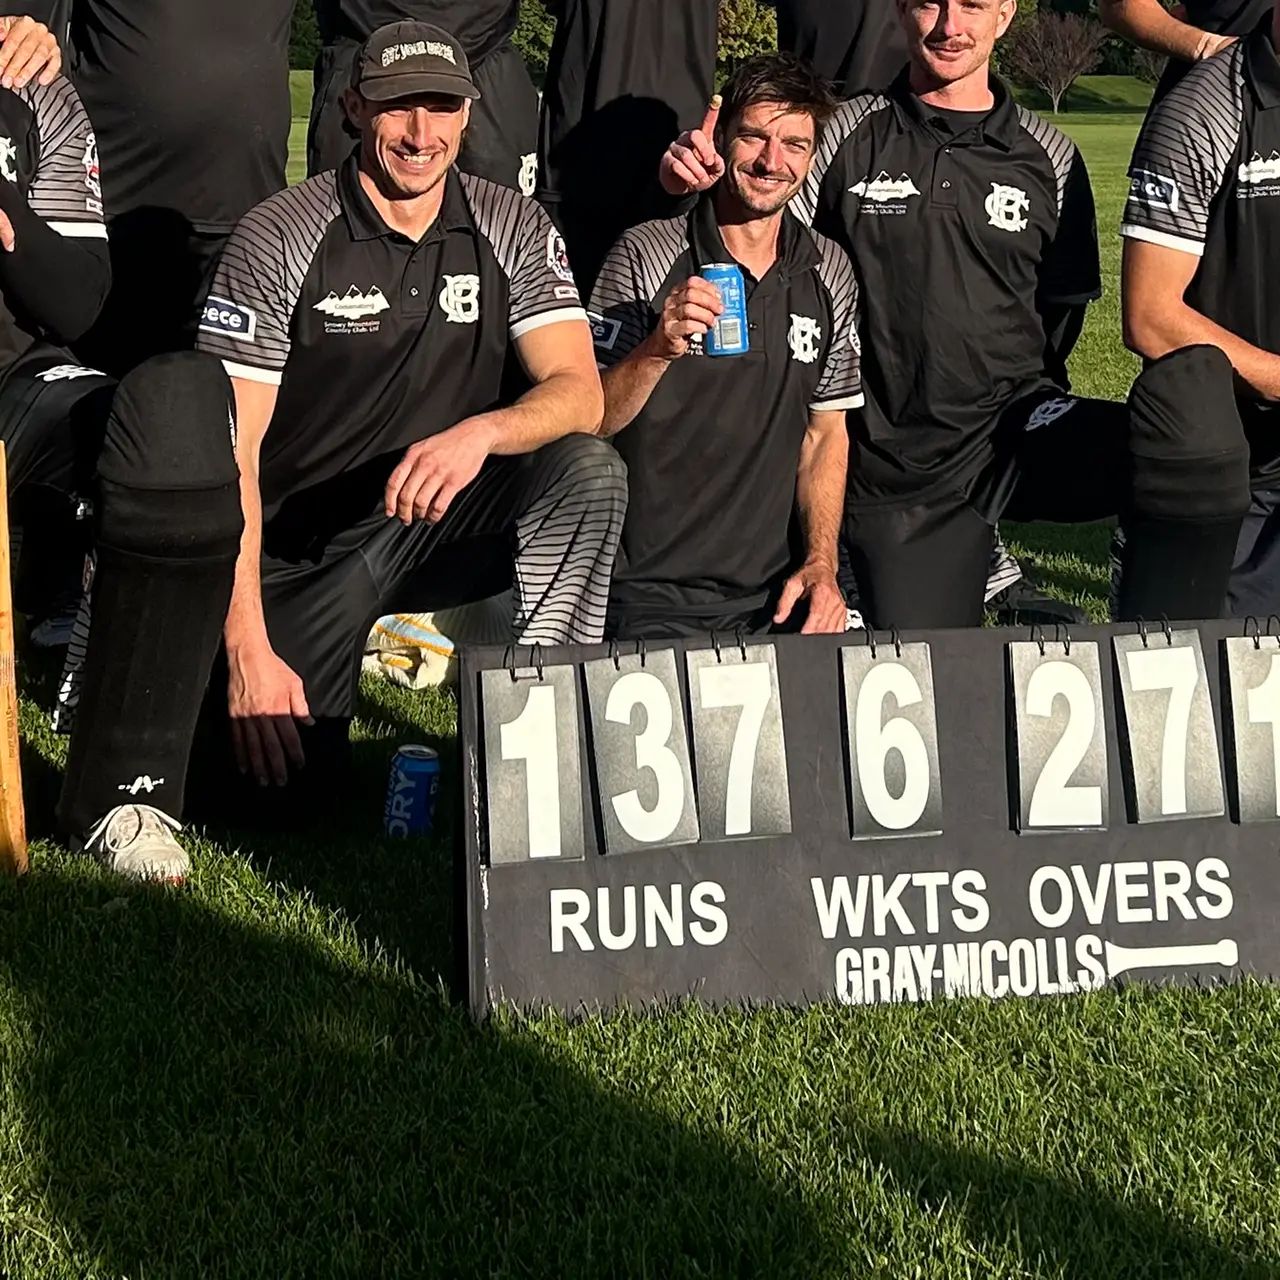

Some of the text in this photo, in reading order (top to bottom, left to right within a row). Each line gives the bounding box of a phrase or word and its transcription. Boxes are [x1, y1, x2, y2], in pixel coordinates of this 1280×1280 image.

[855, 661, 930, 830] 6
[550, 880, 728, 953] RUNS
[810, 868, 991, 939] WKTS
[1028, 856, 1234, 928] OVERS
